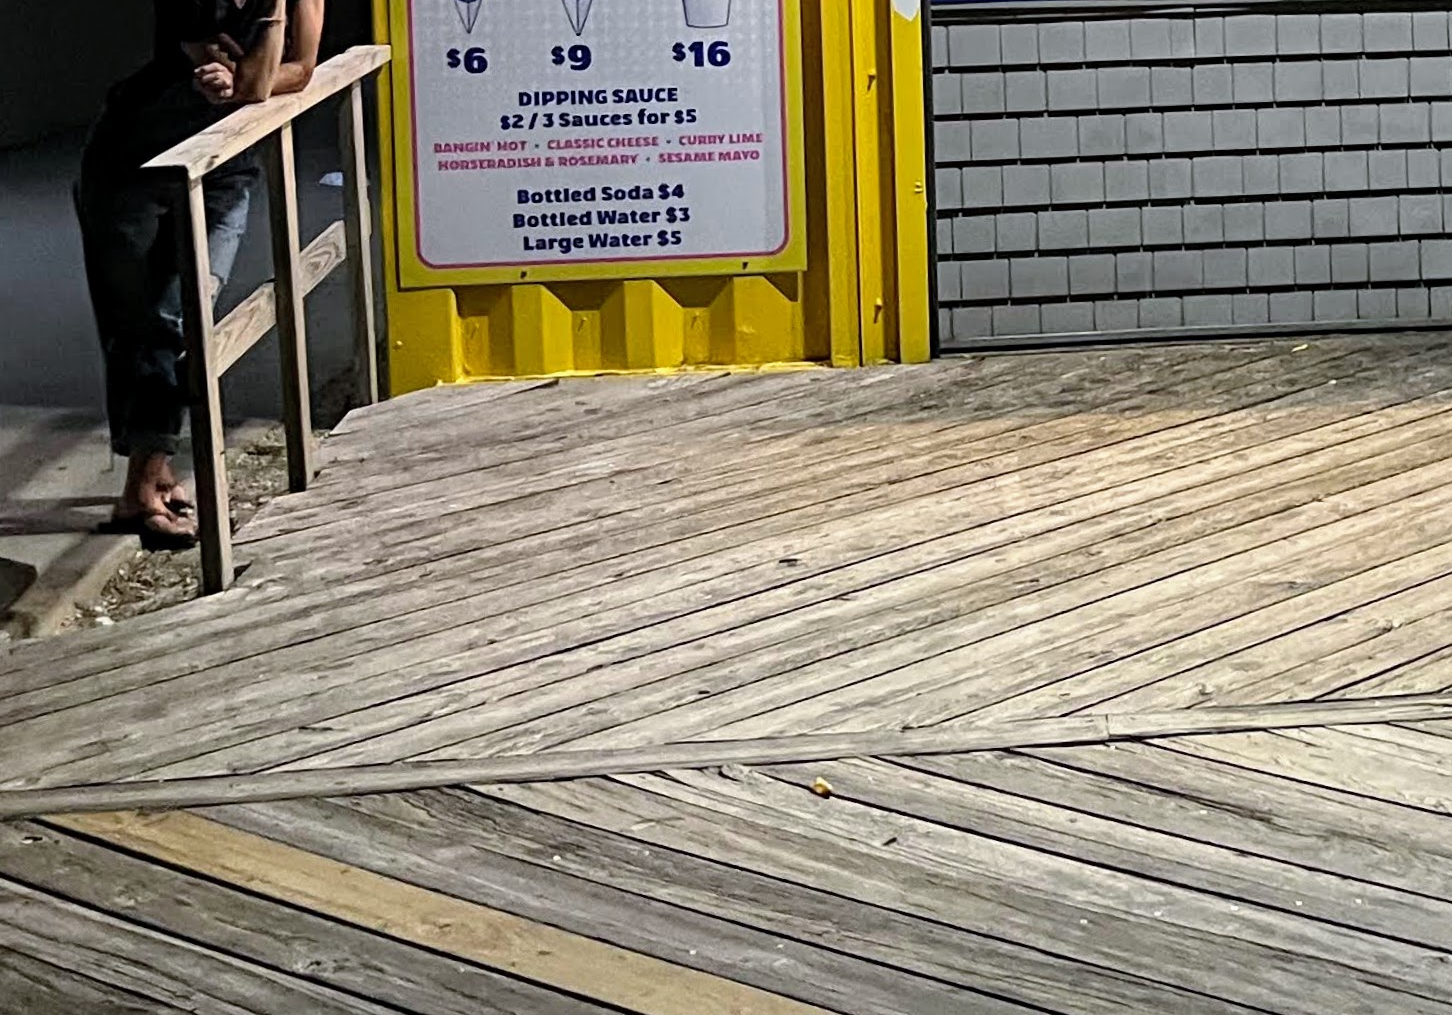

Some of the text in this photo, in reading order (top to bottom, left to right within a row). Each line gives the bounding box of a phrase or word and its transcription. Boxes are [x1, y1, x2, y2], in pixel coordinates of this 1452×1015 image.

[446, 41, 731, 74] $6 $9 $16
[518, 87, 679, 107] DIPPING SAUCE
[500, 108, 697, 131] $2 / 3 Sauces for $5
[497, 140, 527, 152] HOT
[547, 137, 605, 150] CLASSIC
[607, 136, 659, 149] CHEESE
[679, 134, 725, 147] CURRY
[728, 133, 763, 145] LIME
[437, 150, 761, 171] HORSERADISH & ROSEMARY SESAME MAYO
[517, 183, 685, 205] Bottled Soda $4
[512, 206, 690, 229] Bottled Water $3
[522, 230, 682, 255] Large Water $5
